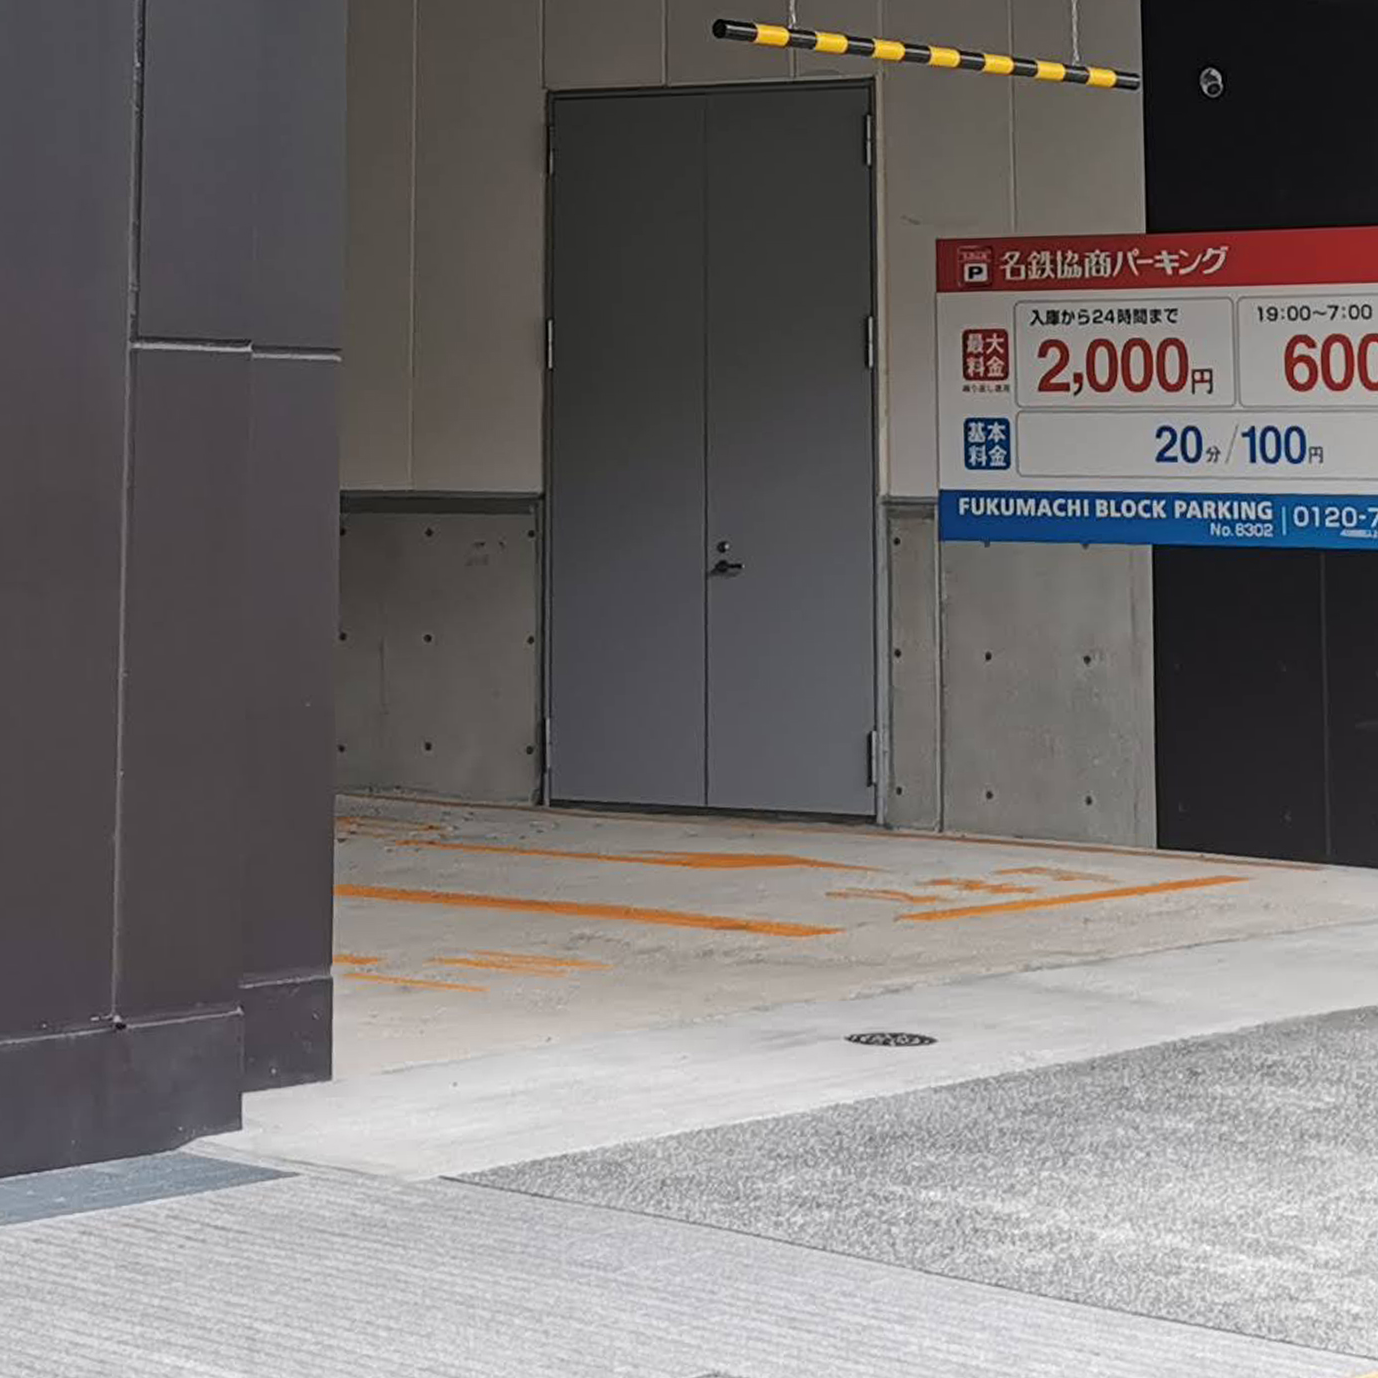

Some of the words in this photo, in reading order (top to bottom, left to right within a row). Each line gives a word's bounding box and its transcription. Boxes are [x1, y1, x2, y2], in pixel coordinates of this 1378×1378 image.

[1000, 246, 1229, 282] 名鉄協商パーキング
[1029, 307, 1178, 326] 入庫から24時間まで
[966, 333, 1004, 354] 最大
[966, 356, 1005, 377] 料金
[1037, 337, 1214, 396] 2,000円
[967, 422, 1006, 443] 基本
[968, 445, 1008, 467] 料金
[958, 497, 1089, 518] FUKUMACHI
[1096, 498, 1166, 519] BLOCK
[1174, 500, 1273, 521] PARKING
